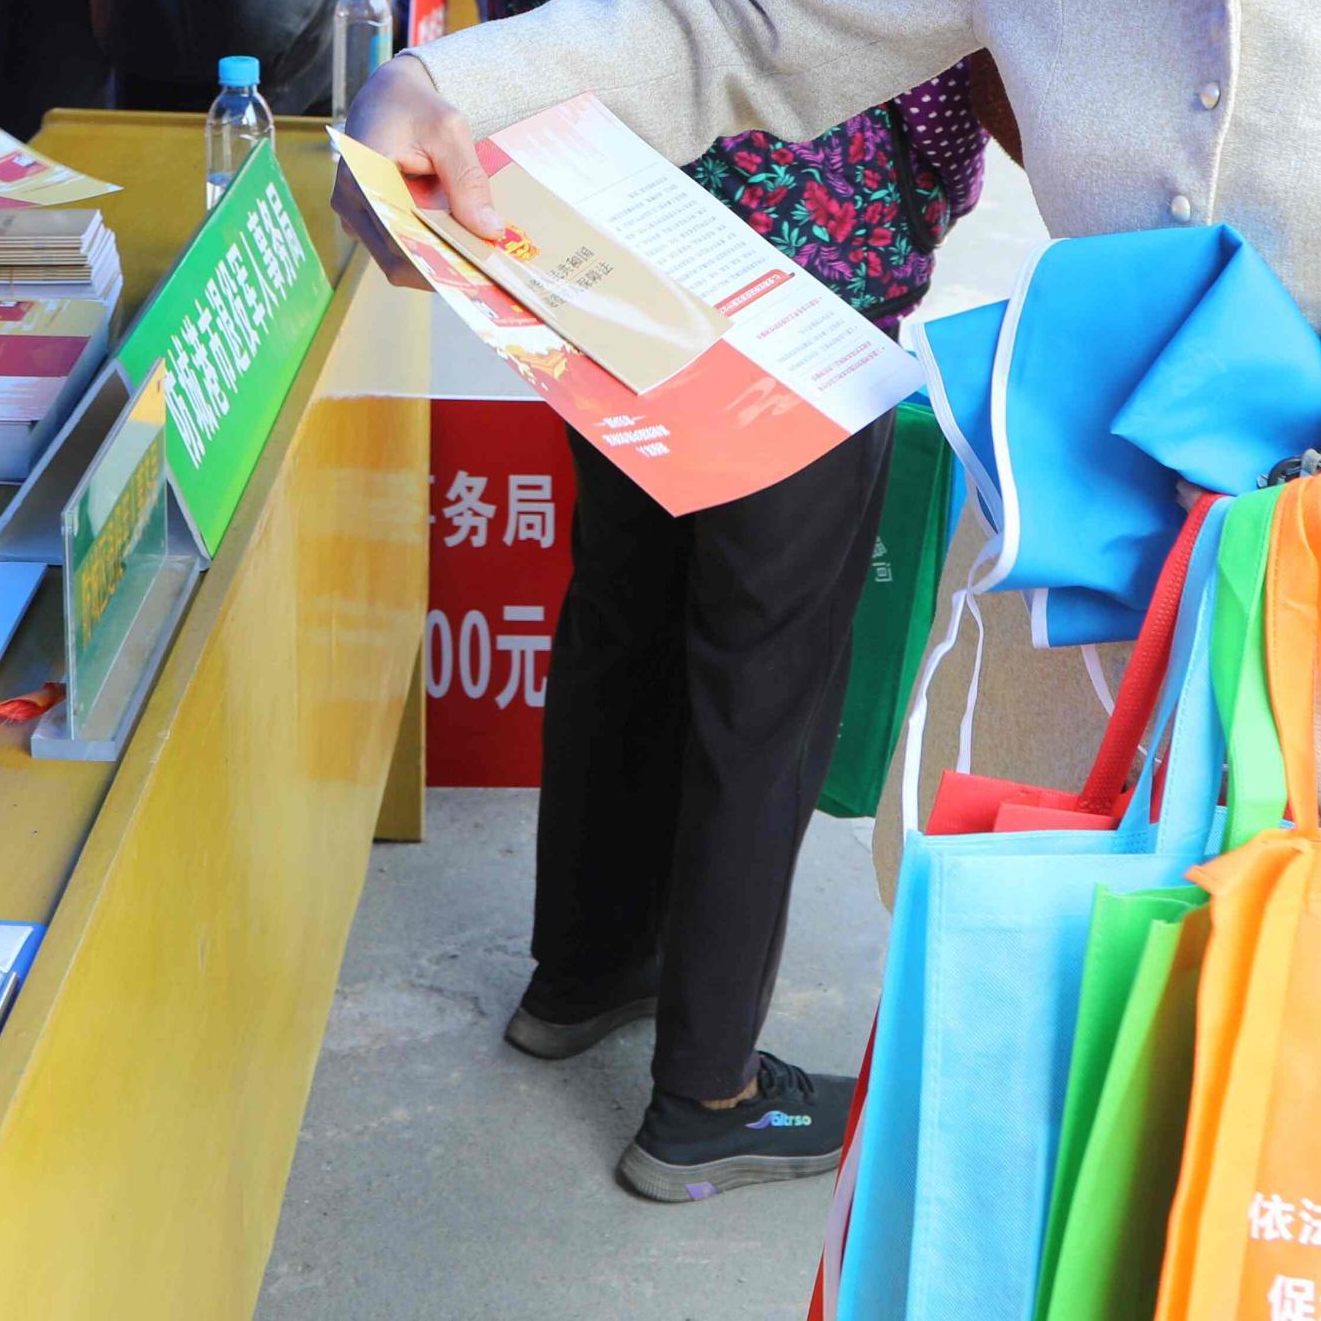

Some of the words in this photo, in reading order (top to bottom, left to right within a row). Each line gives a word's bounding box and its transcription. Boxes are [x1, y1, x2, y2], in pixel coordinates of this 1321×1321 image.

[165, 181, 306, 470] 防城港市退役军人事务局
[429, 473, 554, 548] 务局
